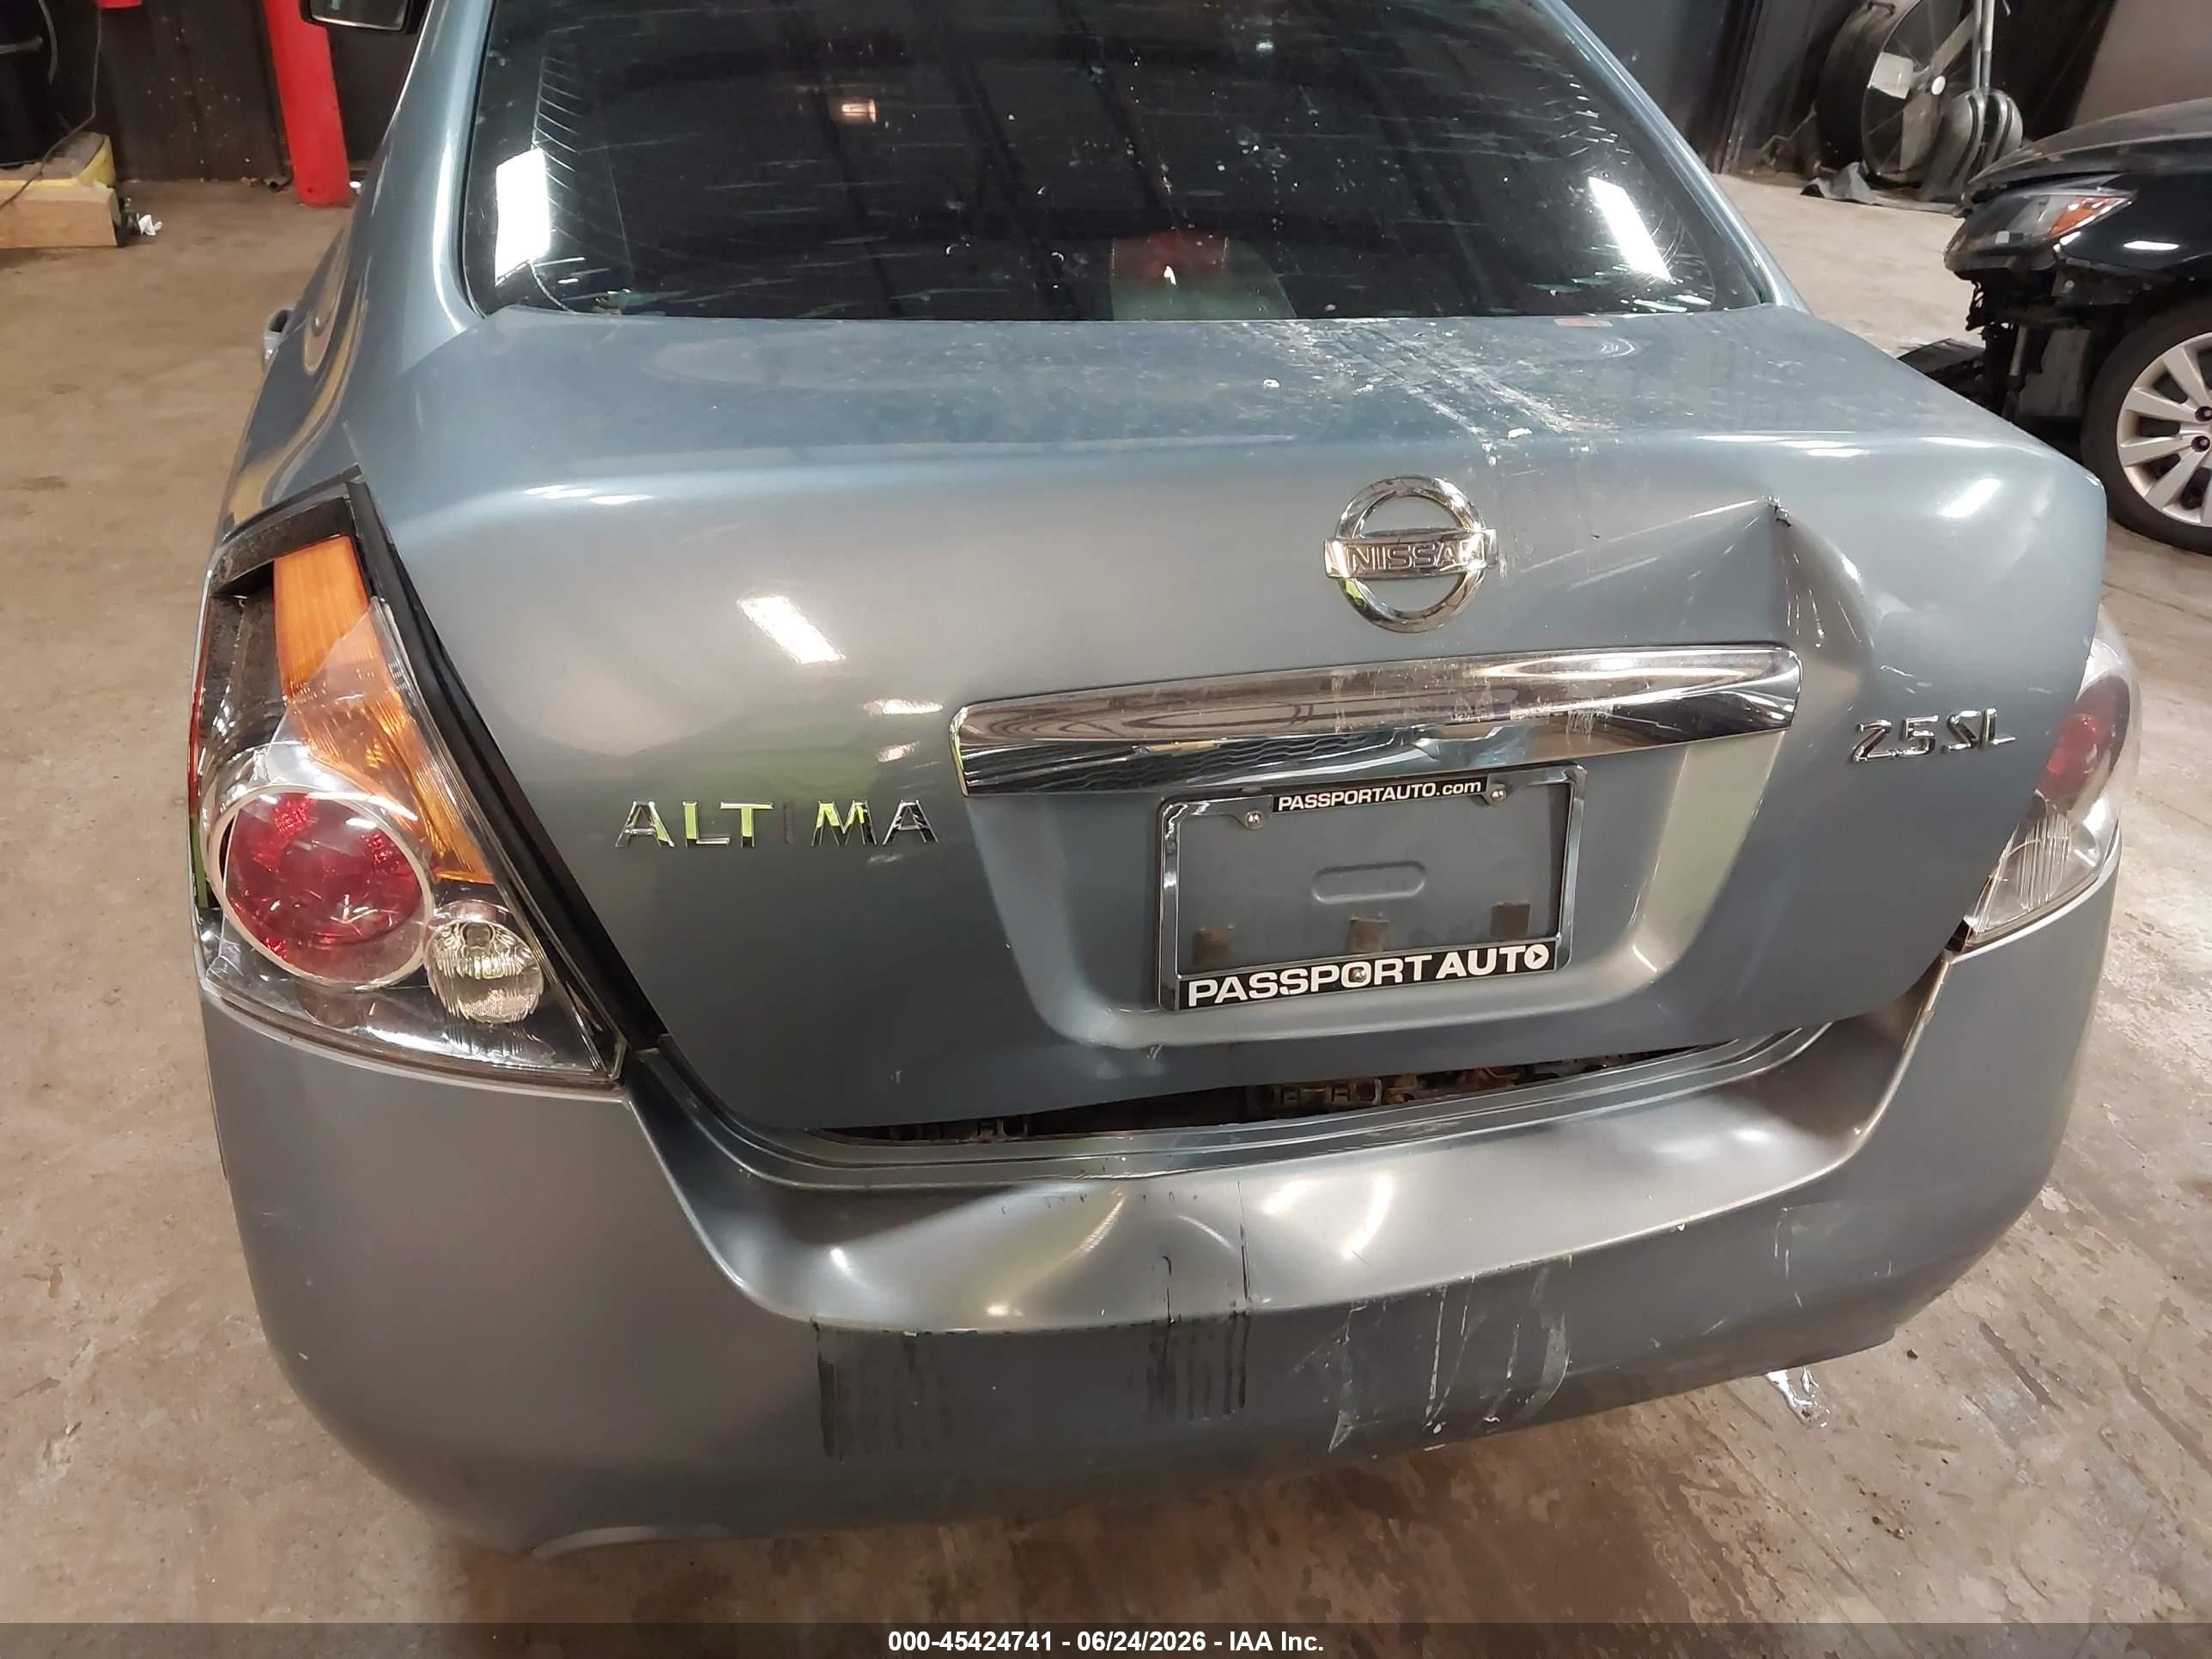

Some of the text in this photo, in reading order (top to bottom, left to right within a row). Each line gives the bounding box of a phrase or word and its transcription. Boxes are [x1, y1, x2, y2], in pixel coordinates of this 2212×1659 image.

[1348, 540, 1485, 570] NISSAN
[1941, 707, 2017, 752] SL
[1278, 780, 1481, 811] PASSPORTAUTO.com
[1188, 945, 1550, 1007] PASSPORT AUTO
